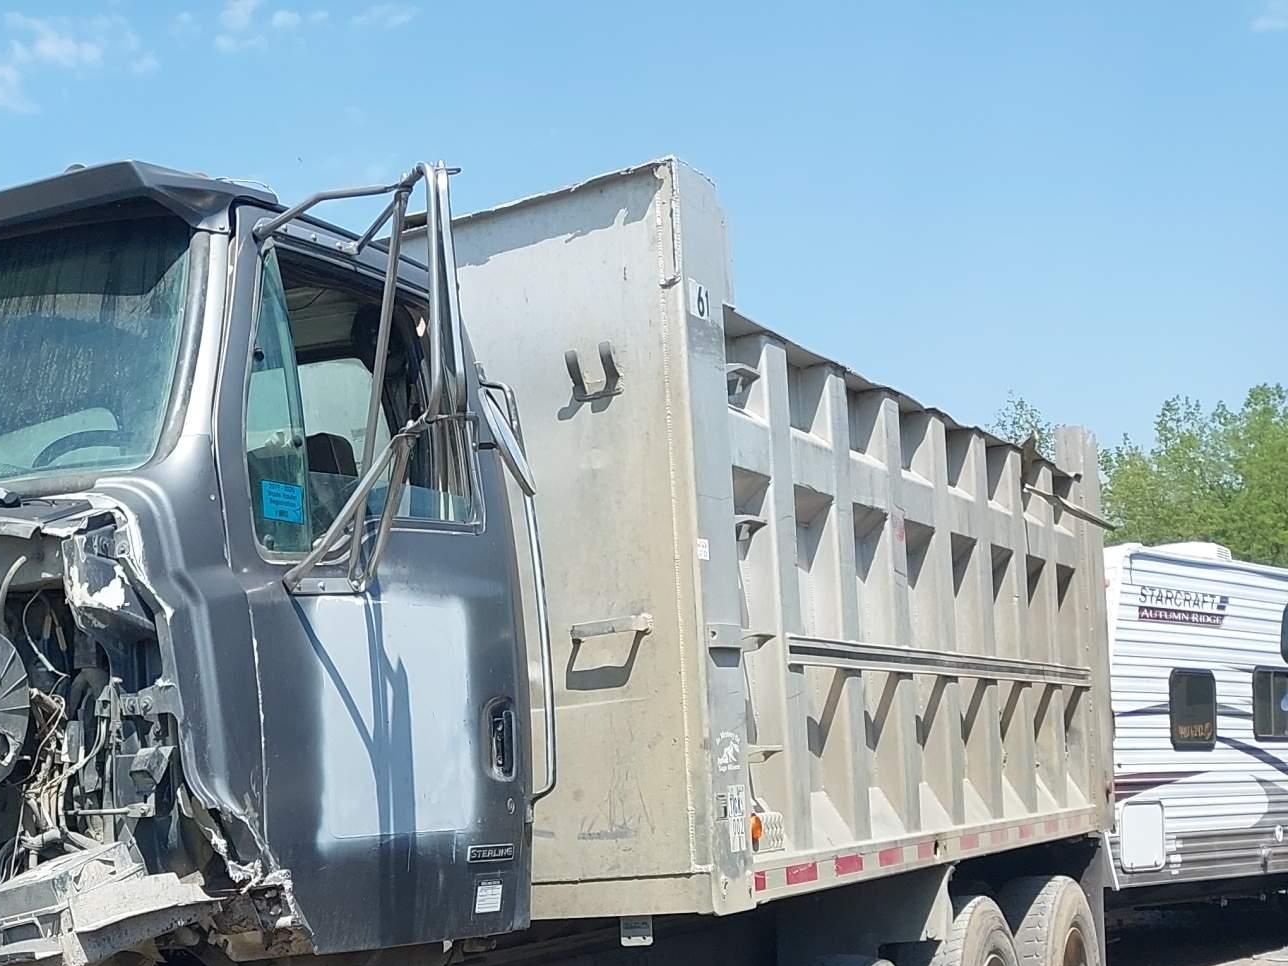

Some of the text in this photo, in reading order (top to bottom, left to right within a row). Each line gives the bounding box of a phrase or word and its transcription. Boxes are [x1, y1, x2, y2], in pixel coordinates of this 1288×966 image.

[697, 286, 710, 317] 61
[1139, 586, 1216, 610] STARCRAFT
[1141, 608, 1224, 625] AUTUMN RIDGE
[471, 847, 512, 859] STERLING
